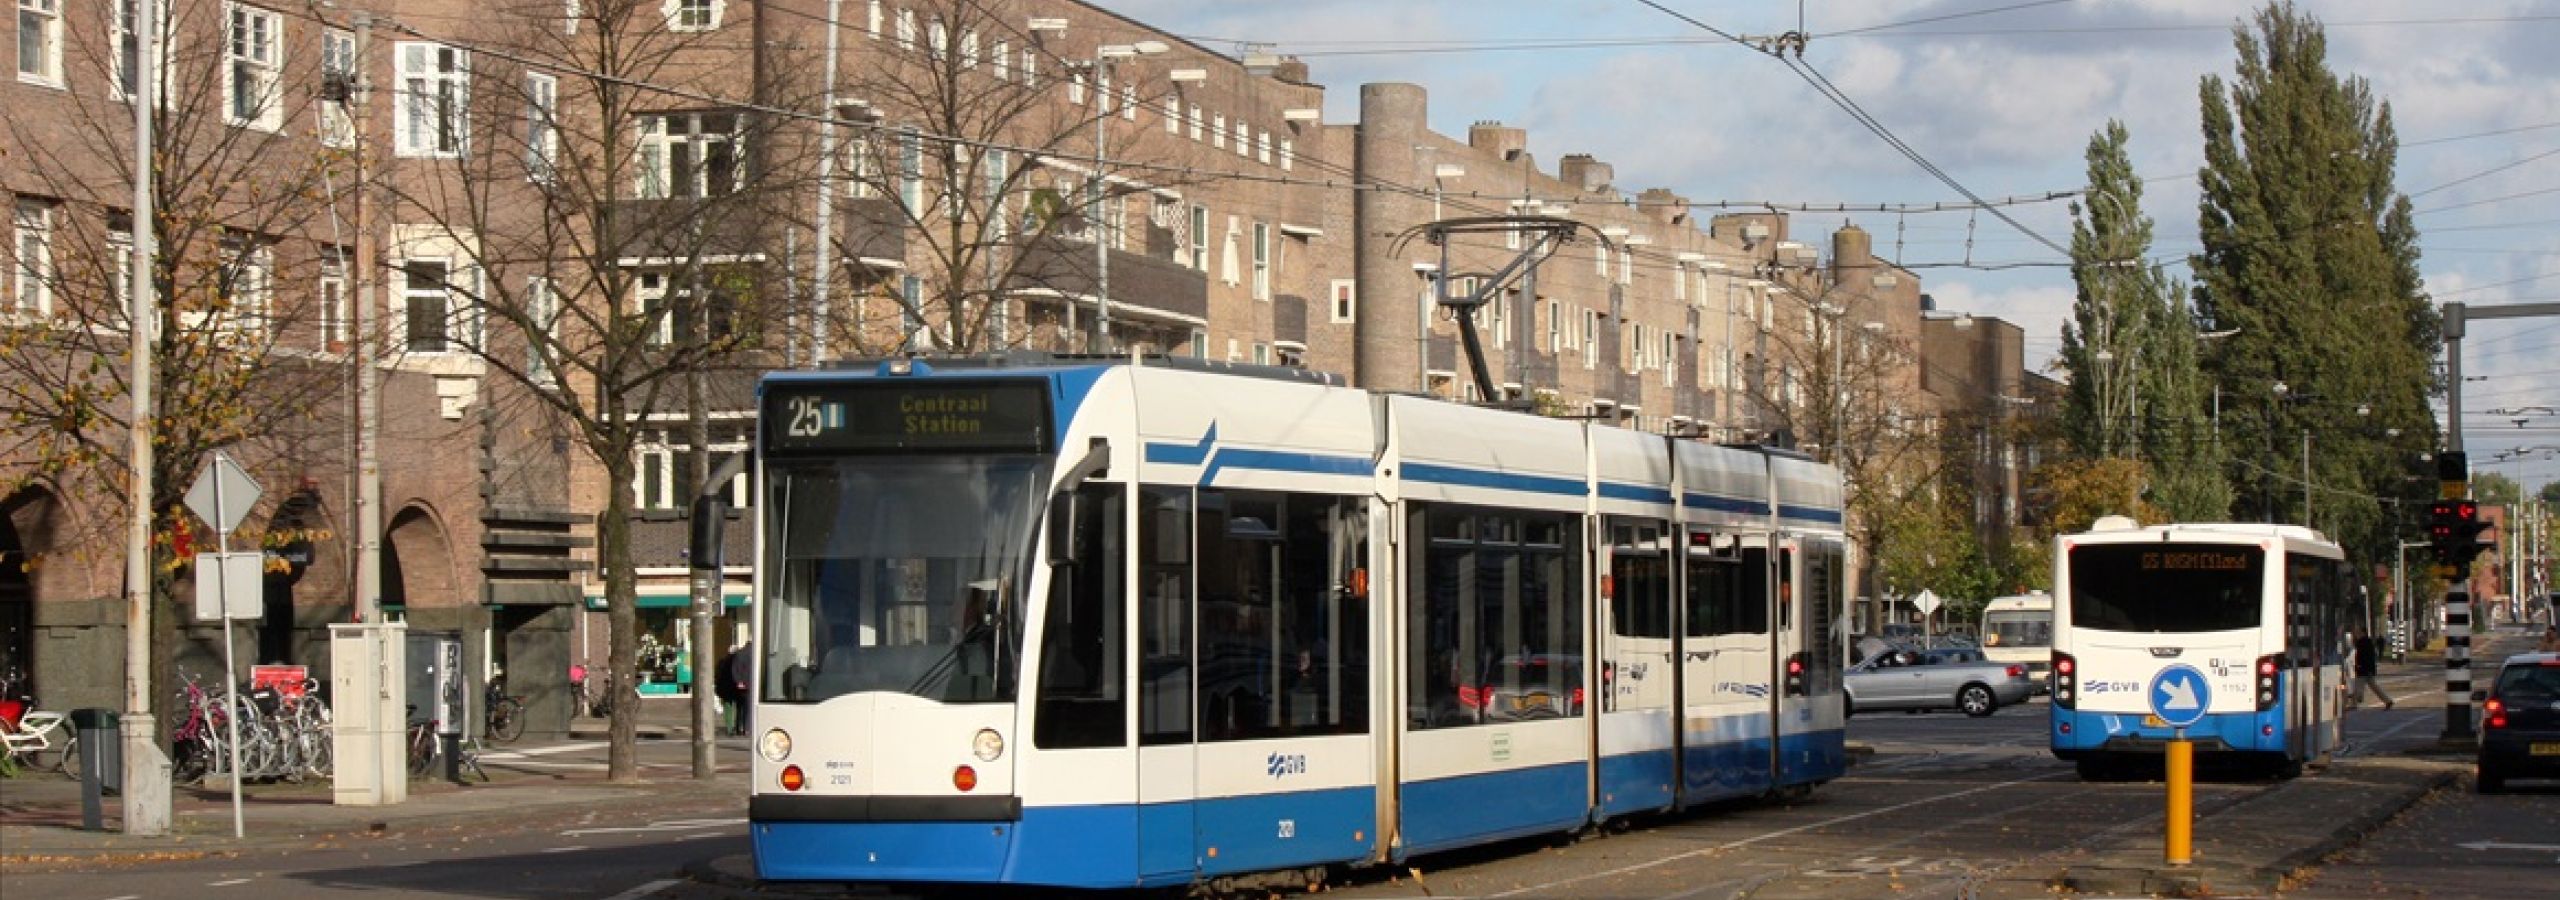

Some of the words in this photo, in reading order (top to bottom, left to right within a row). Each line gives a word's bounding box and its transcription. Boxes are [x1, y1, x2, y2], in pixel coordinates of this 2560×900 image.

[901, 394, 988, 412] Centraal
[788, 396, 822, 436] 25
[905, 414, 980, 433] Station
[2111, 682, 2140, 692] GVB
